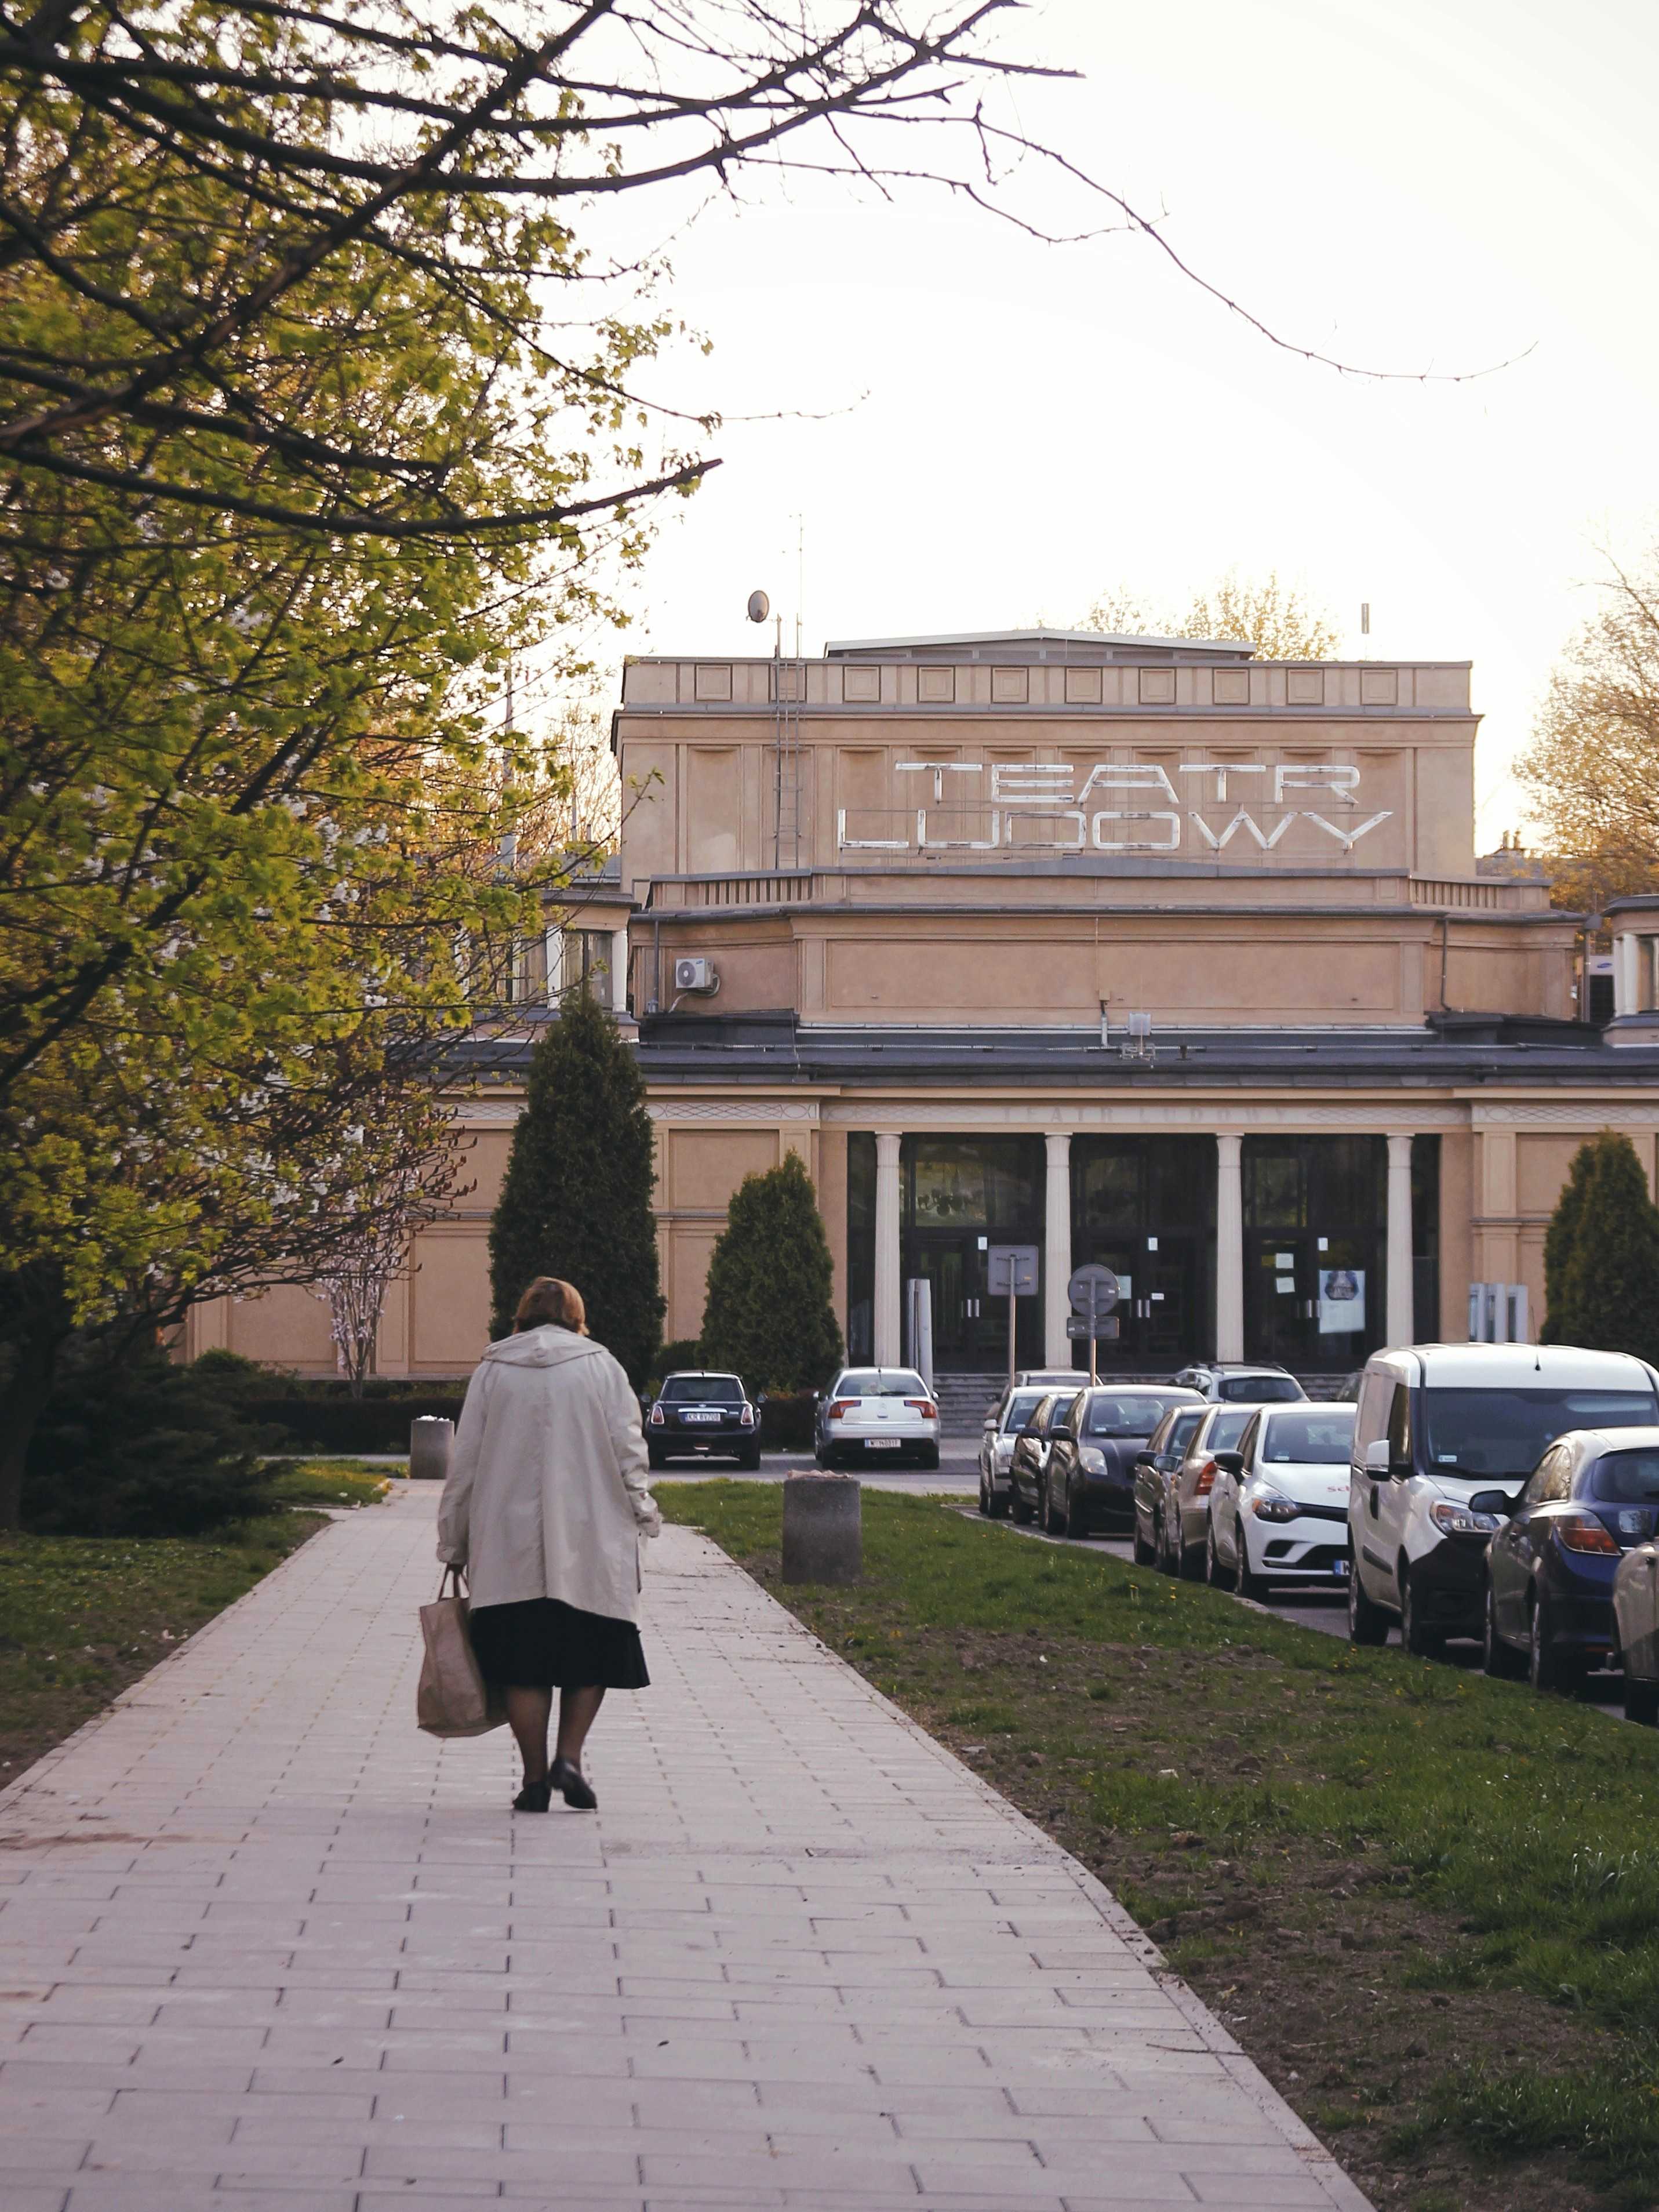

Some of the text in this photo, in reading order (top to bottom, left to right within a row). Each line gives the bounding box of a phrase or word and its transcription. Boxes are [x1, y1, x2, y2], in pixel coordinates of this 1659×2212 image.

[896, 762, 1360, 803] TEATR
[838, 809, 1394, 850] LUDOWY
[1002, 1106, 1286, 1124] TEATR LUDOWY
